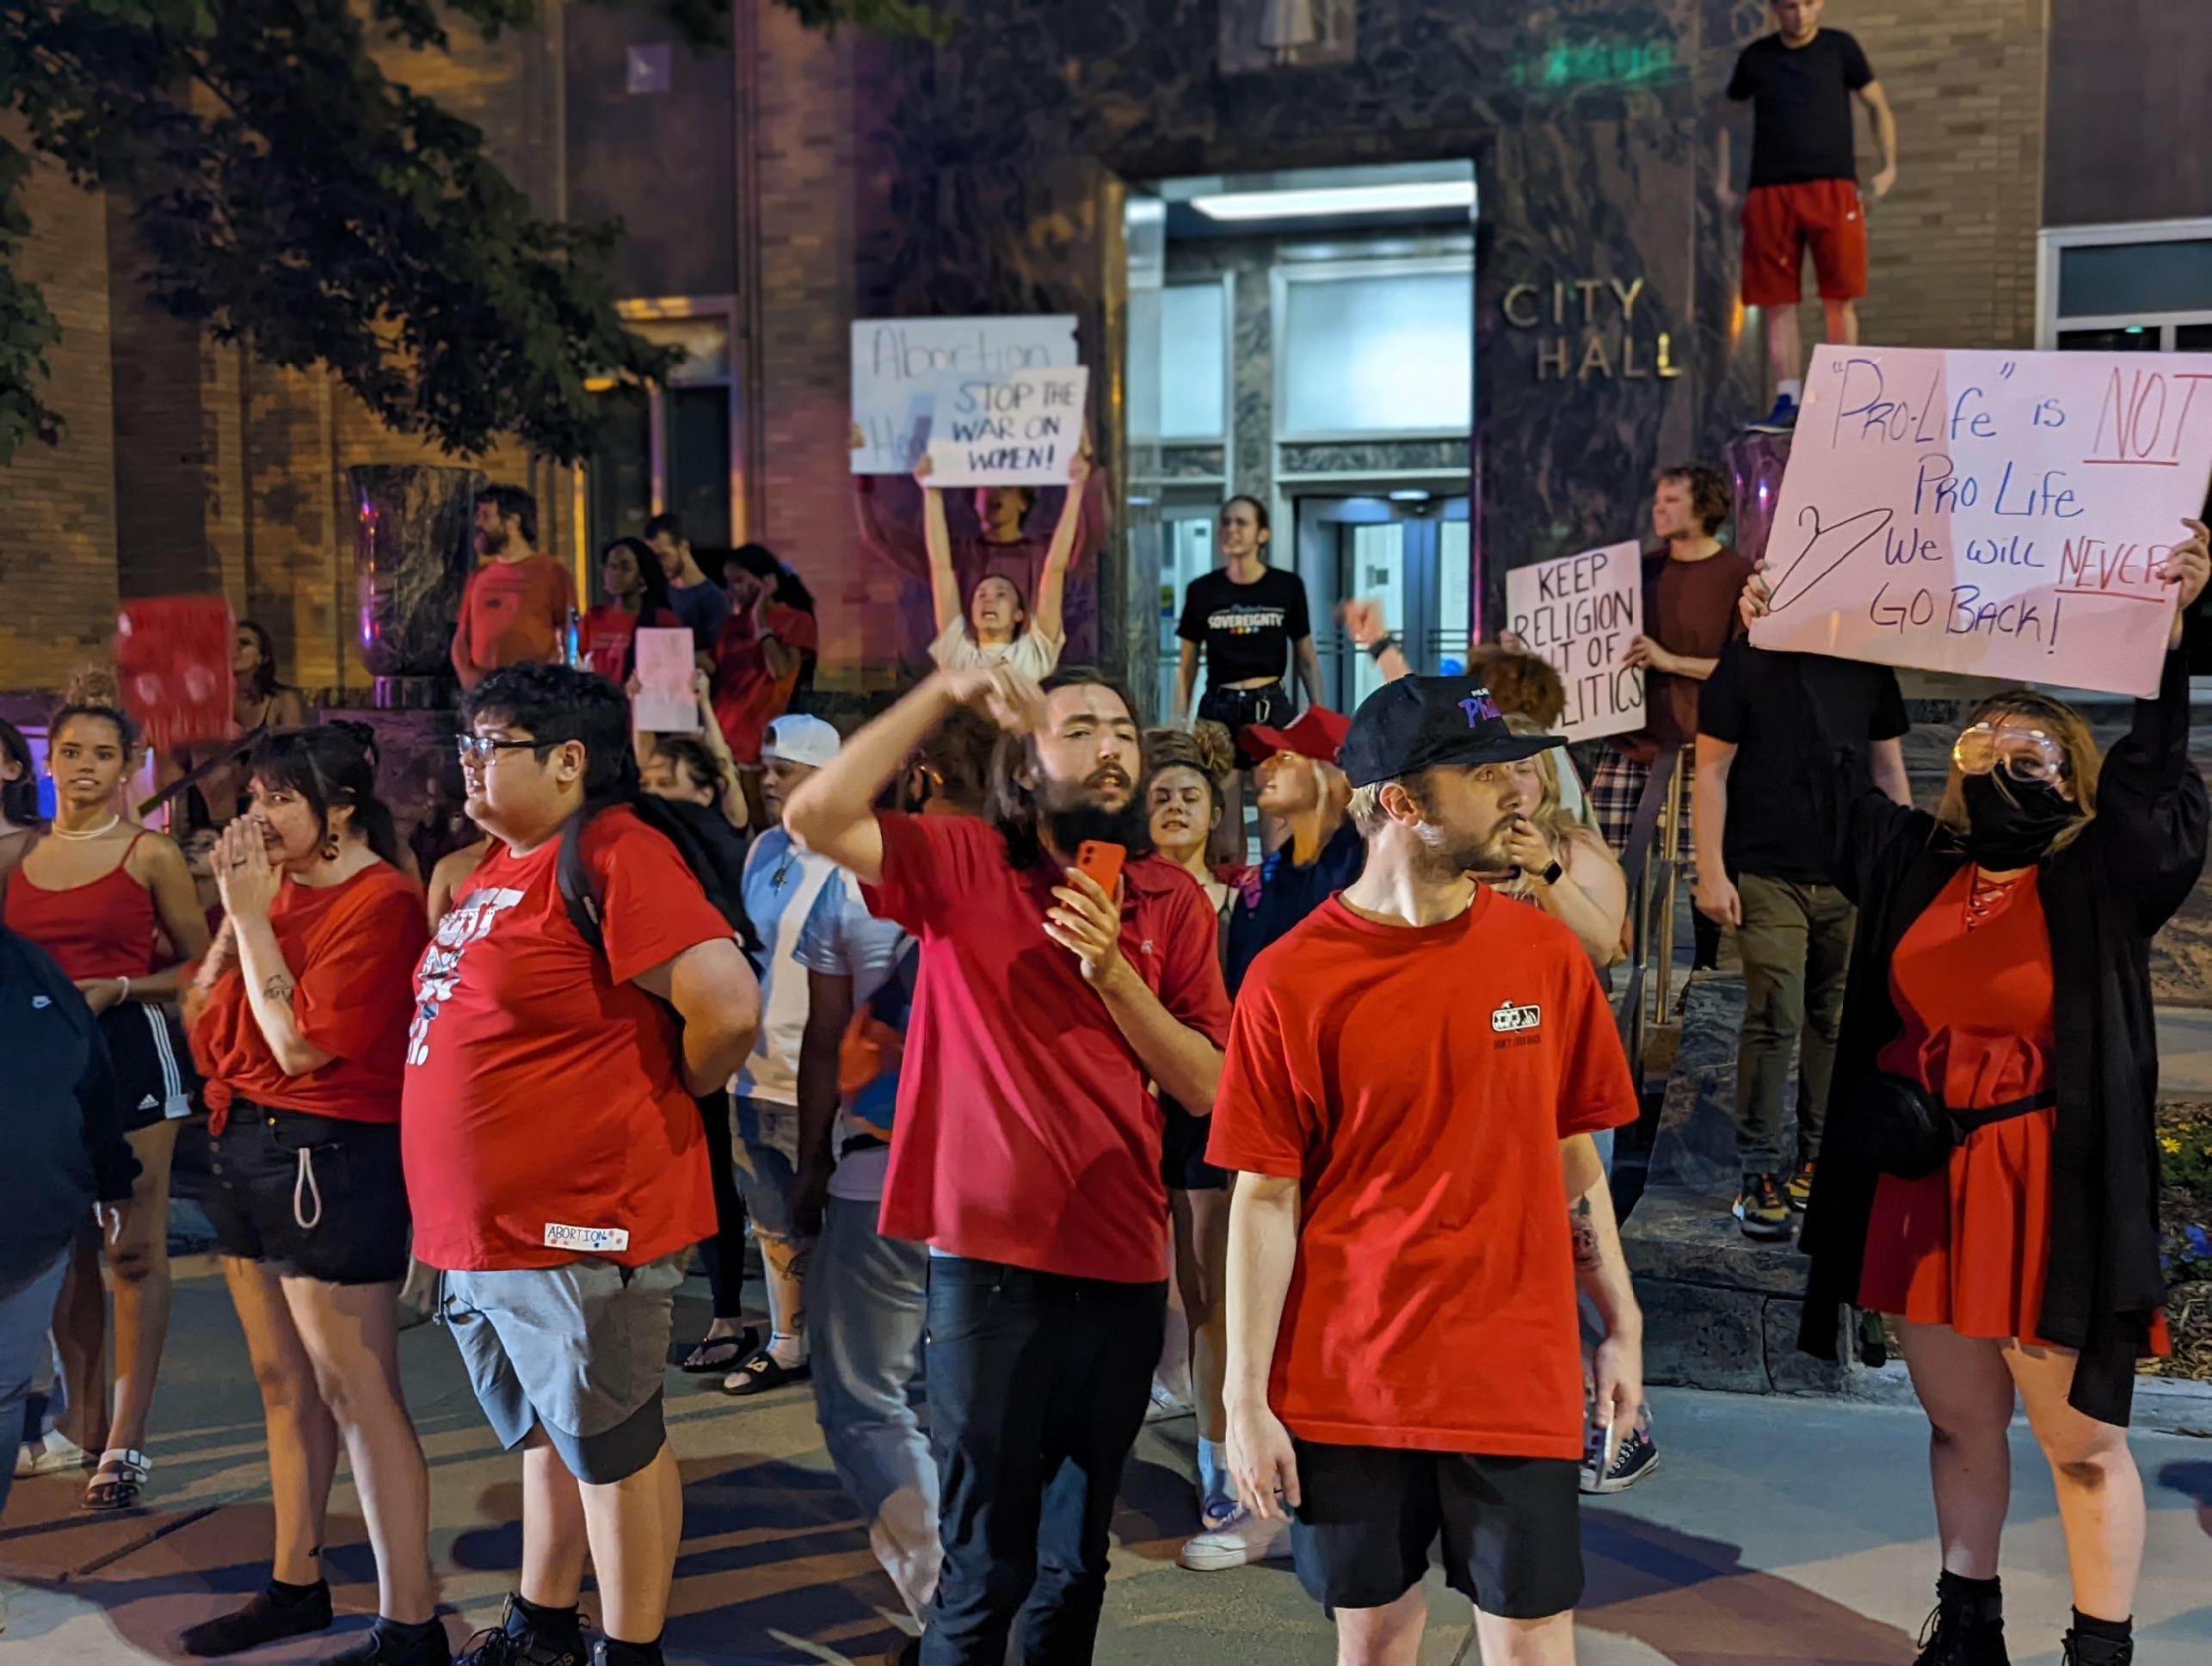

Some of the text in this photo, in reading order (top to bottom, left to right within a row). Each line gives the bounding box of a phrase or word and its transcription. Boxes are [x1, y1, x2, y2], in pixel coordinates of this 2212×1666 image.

[1503, 278, 1644, 327] CITY
[872, 325, 1052, 380] Abortion
[1537, 332, 1683, 380] HALL
[954, 380, 1077, 414] STOP THE
[2092, 366, 2212, 460] NOT
[952, 416, 1061, 444] WAR ON
[968, 443, 1055, 472] WOMEN!
[1537, 552, 1608, 602] KEEP
[1885, 527, 2175, 594] We will NEVER
[1207, 613, 1285, 628] SOVEREIGNTY
[1514, 587, 1634, 650] RELIGION
[1870, 582, 2061, 655] GO BACK!
[1587, 632, 1620, 668] OF
